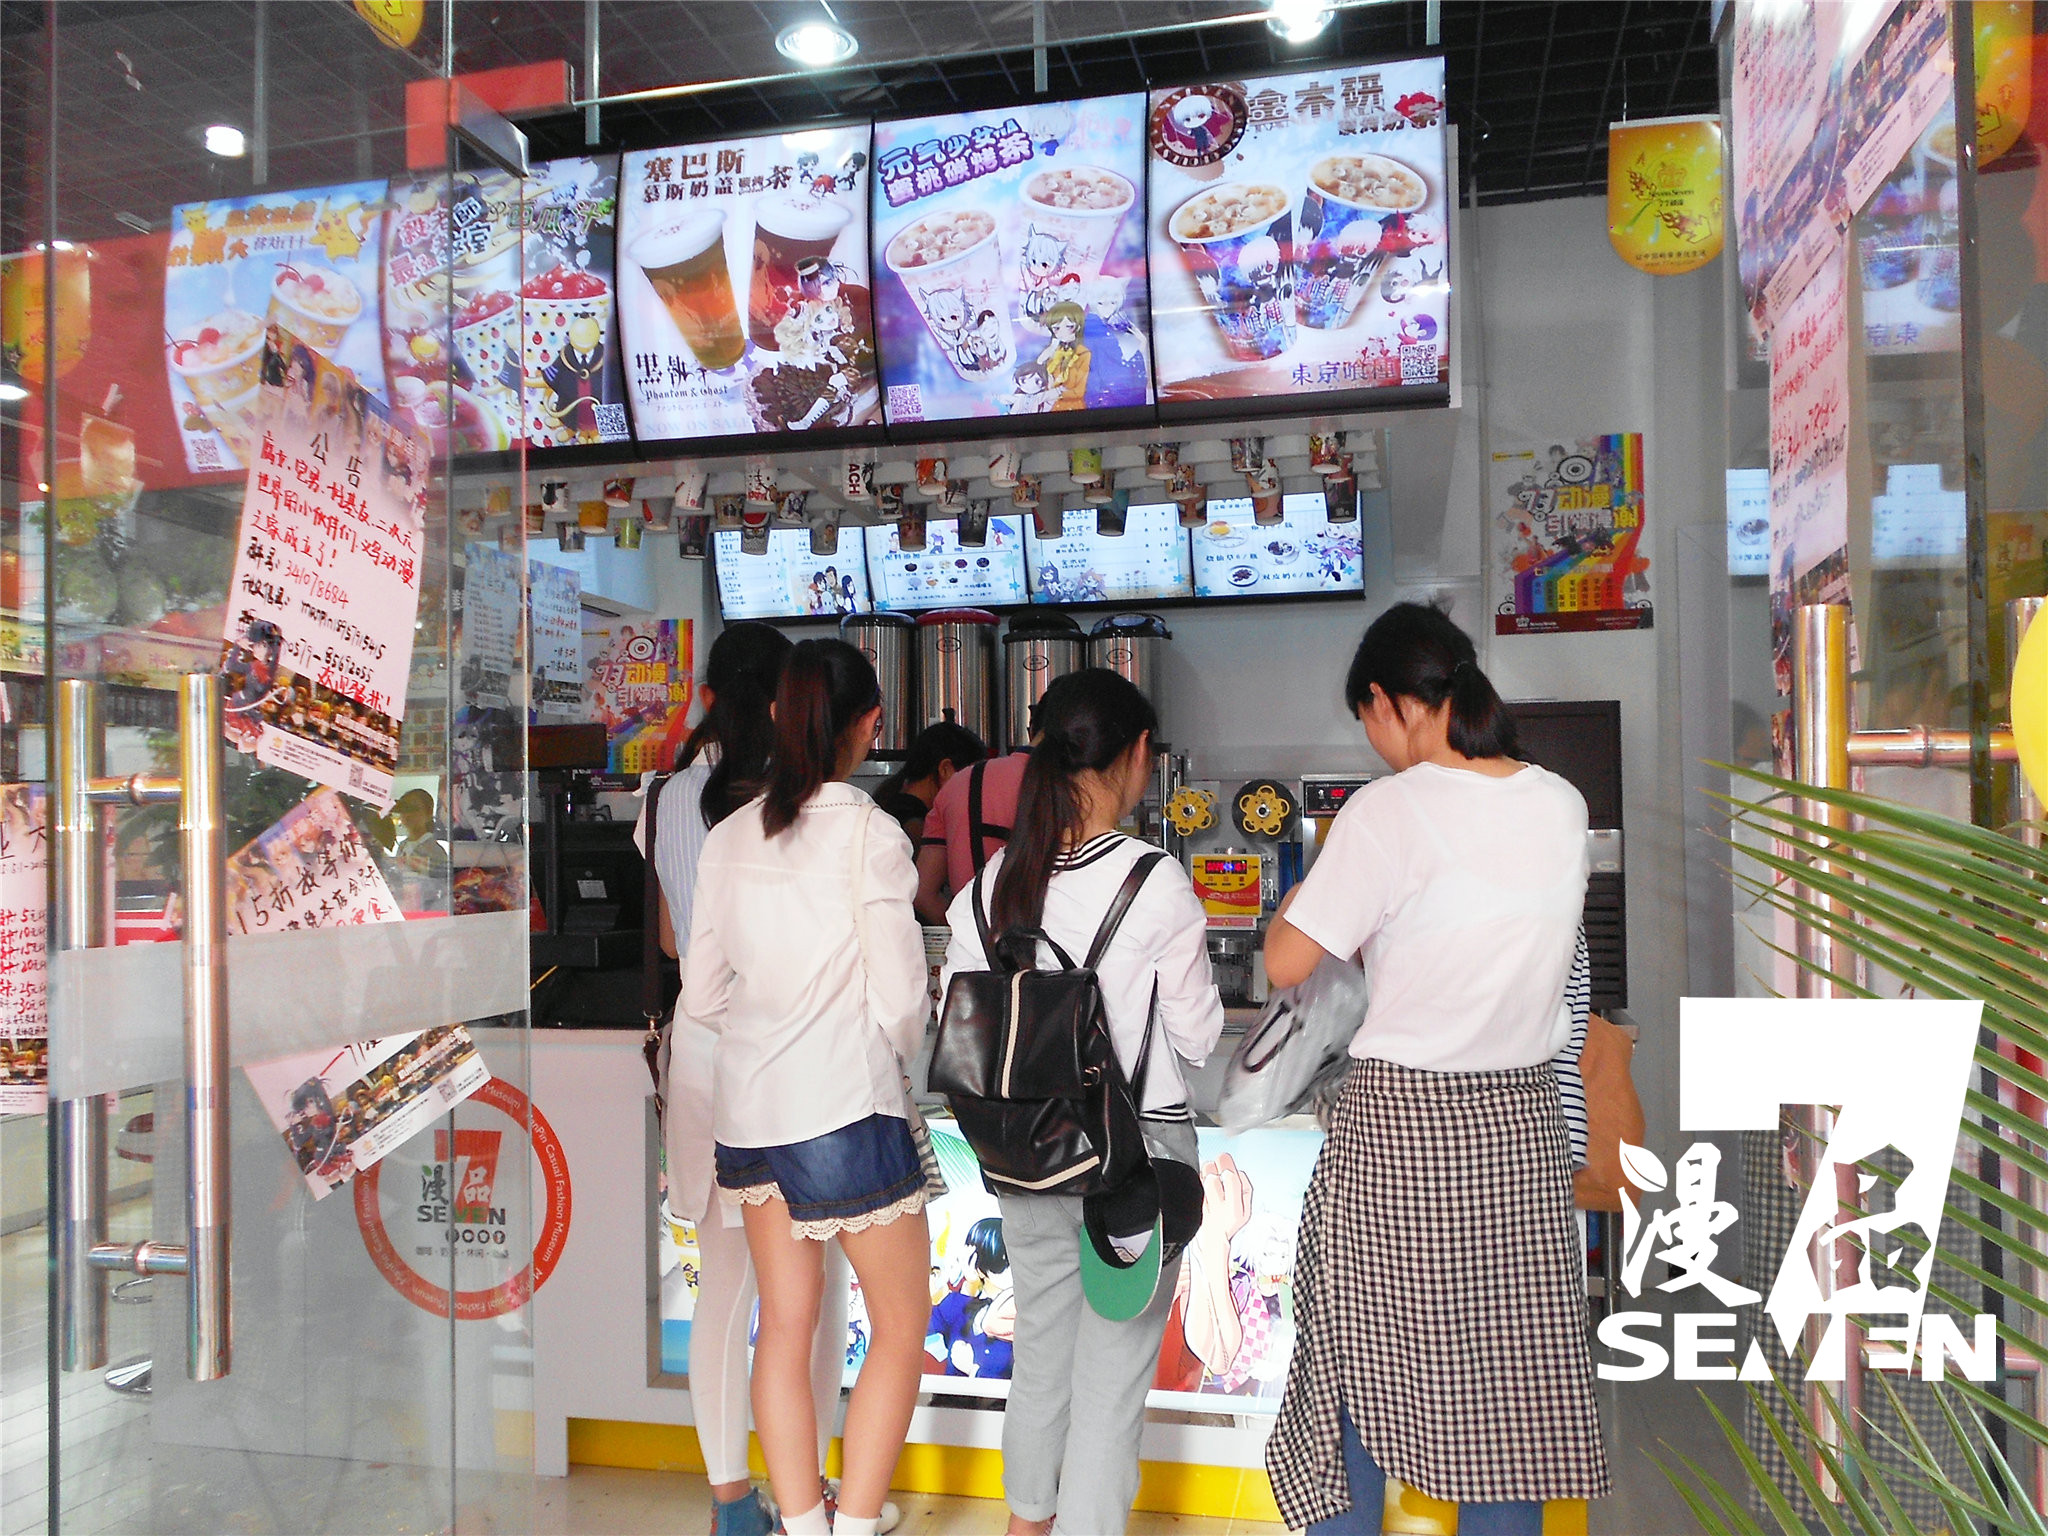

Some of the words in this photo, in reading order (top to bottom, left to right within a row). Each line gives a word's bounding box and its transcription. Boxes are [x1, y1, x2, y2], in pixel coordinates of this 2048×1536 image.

[310, 432, 363, 488] 公告
[546, 1143, 563, 1179] Casual
[417, 1204, 506, 1226] SEVEN
[555, 1179, 566, 1220] Fashion
[542, 1221, 565, 1262] Museum
